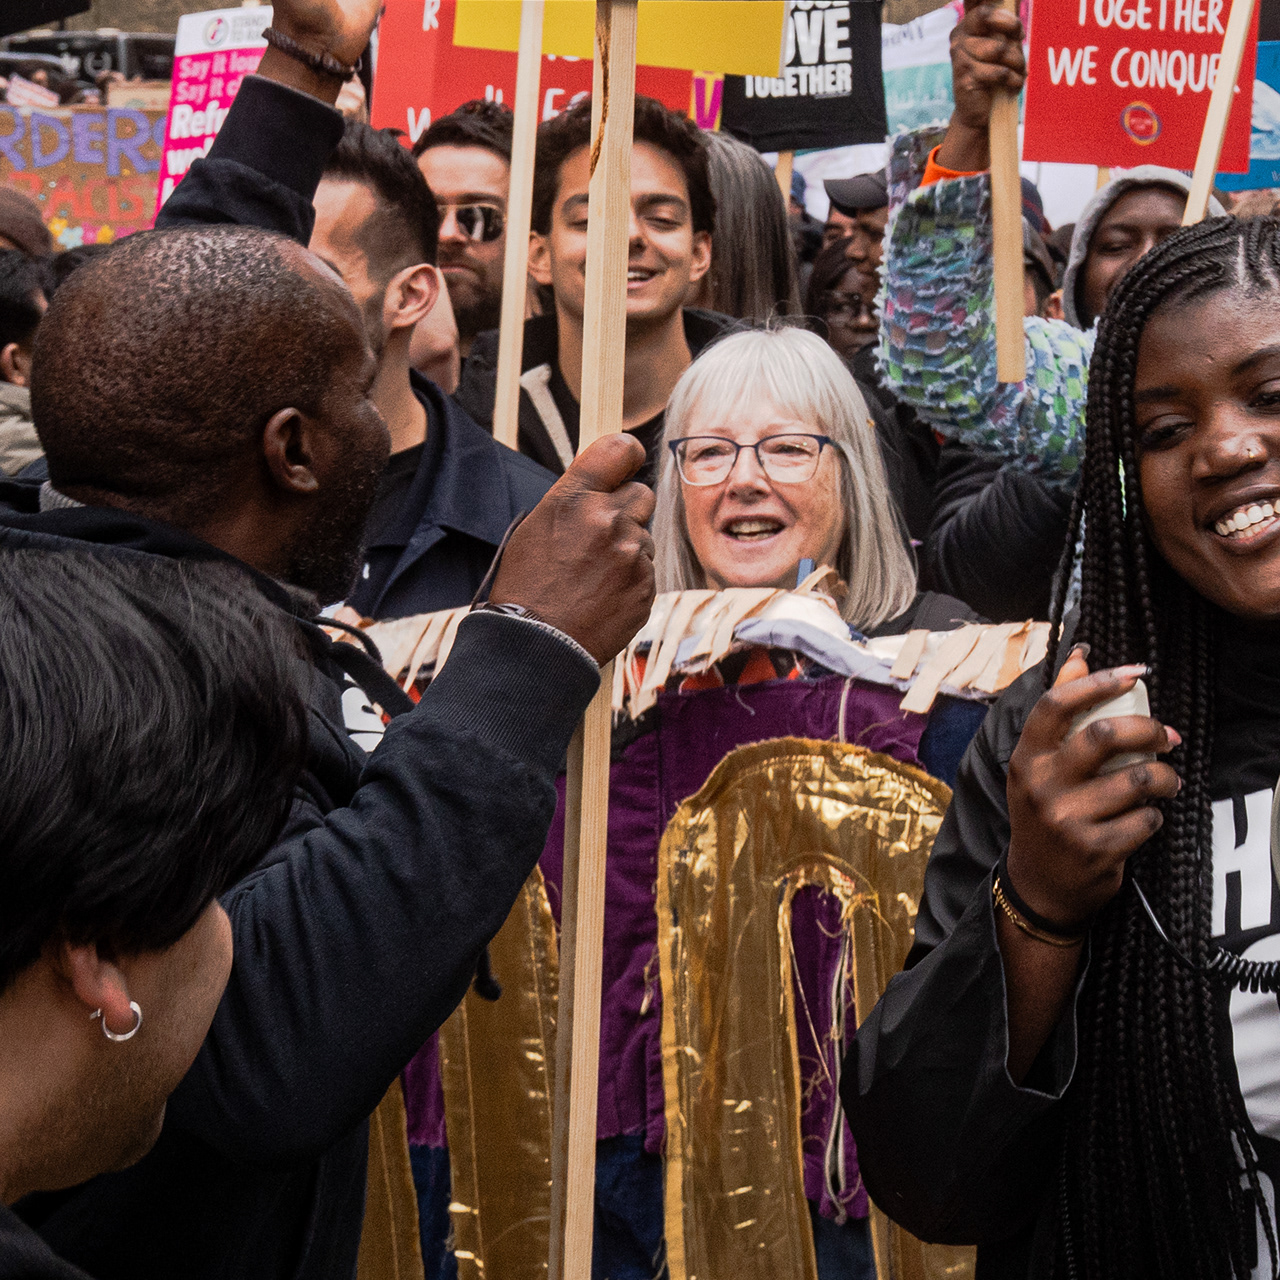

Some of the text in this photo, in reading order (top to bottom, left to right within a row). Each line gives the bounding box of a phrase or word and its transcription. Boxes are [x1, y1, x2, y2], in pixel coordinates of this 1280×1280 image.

[785, 7, 852, 66] VE
[179, 57, 211, 82] Say
[744, 62, 853, 99] TOGETHER
[1047, 47, 1241, 96] WE CONQUE
[176, 81, 208, 106] Say
